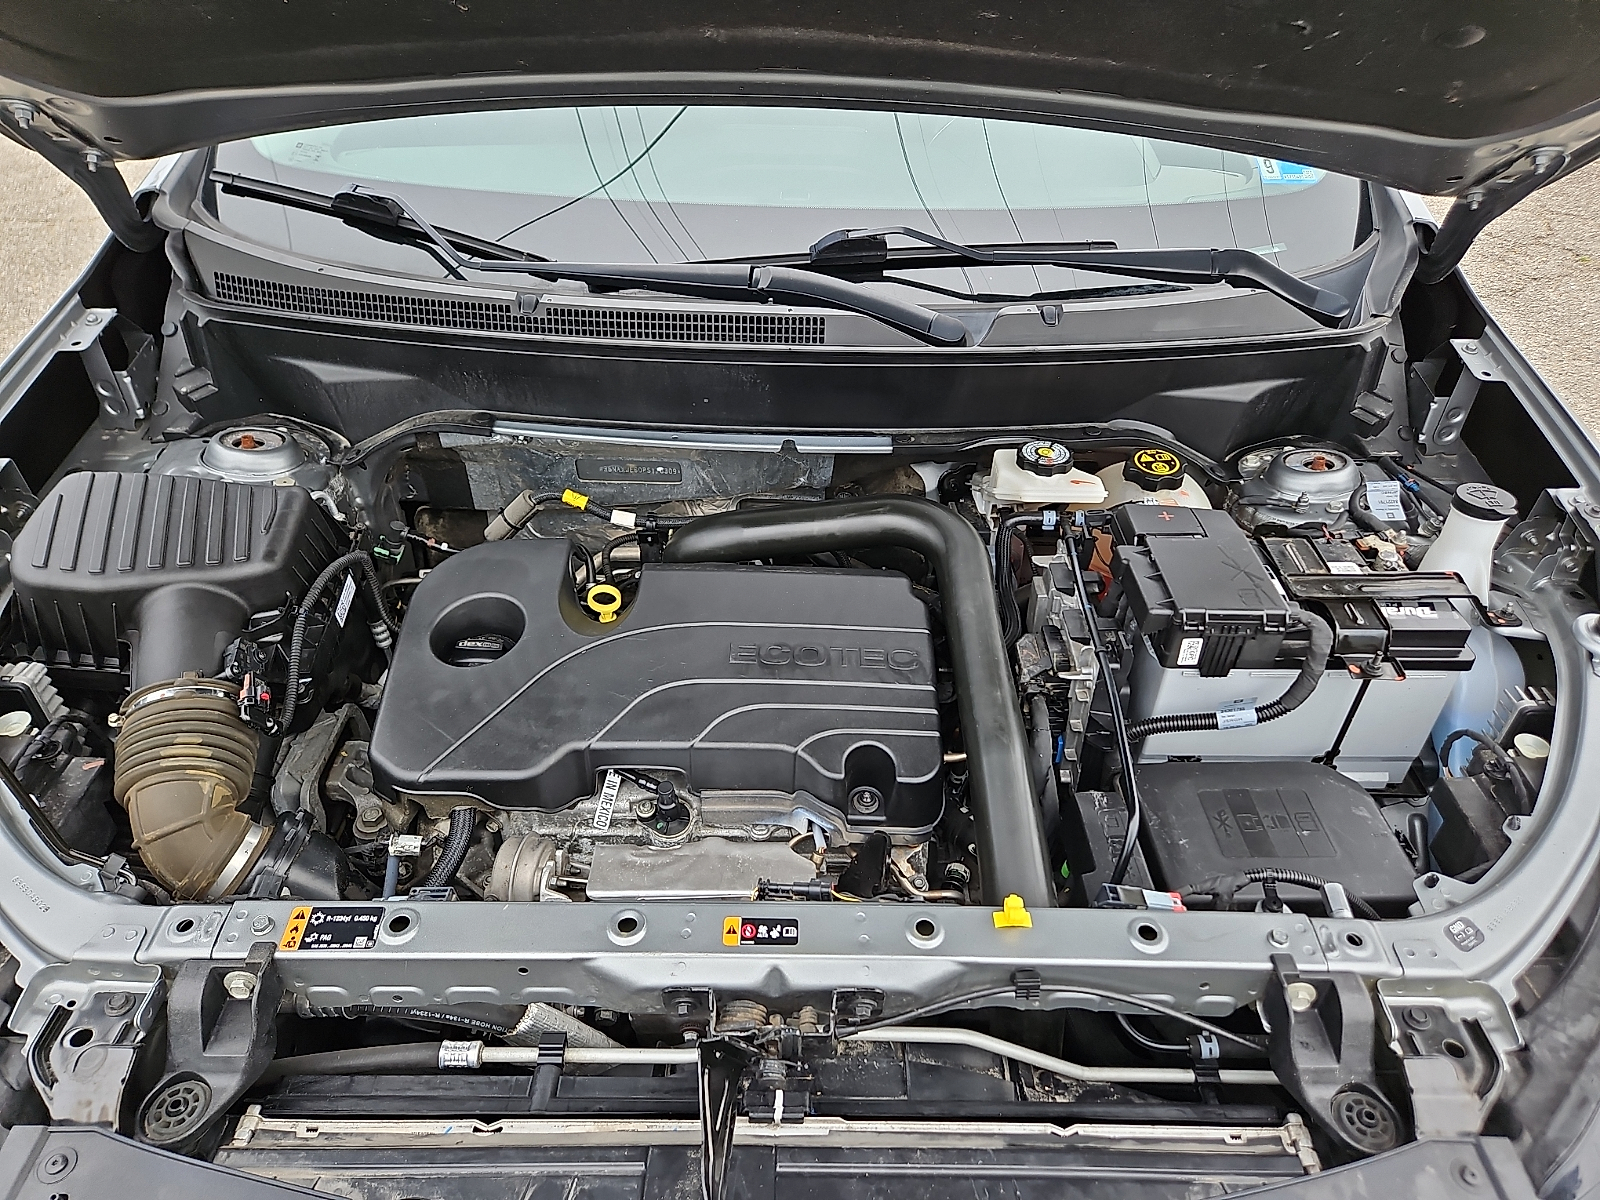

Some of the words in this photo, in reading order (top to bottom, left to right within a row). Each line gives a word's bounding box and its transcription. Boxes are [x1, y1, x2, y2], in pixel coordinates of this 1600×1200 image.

[729, 642, 920, 671] ECOTEC
[606, 780, 617, 790] IN
[596, 792, 614, 827] MEXICO
[326, 914, 352, 923] R-1234yf
[410, 1009, 440, 1018] R-1234yf
[445, 1014, 470, 1024] R-134a
[471, 1020, 491, 1029] HOSE
